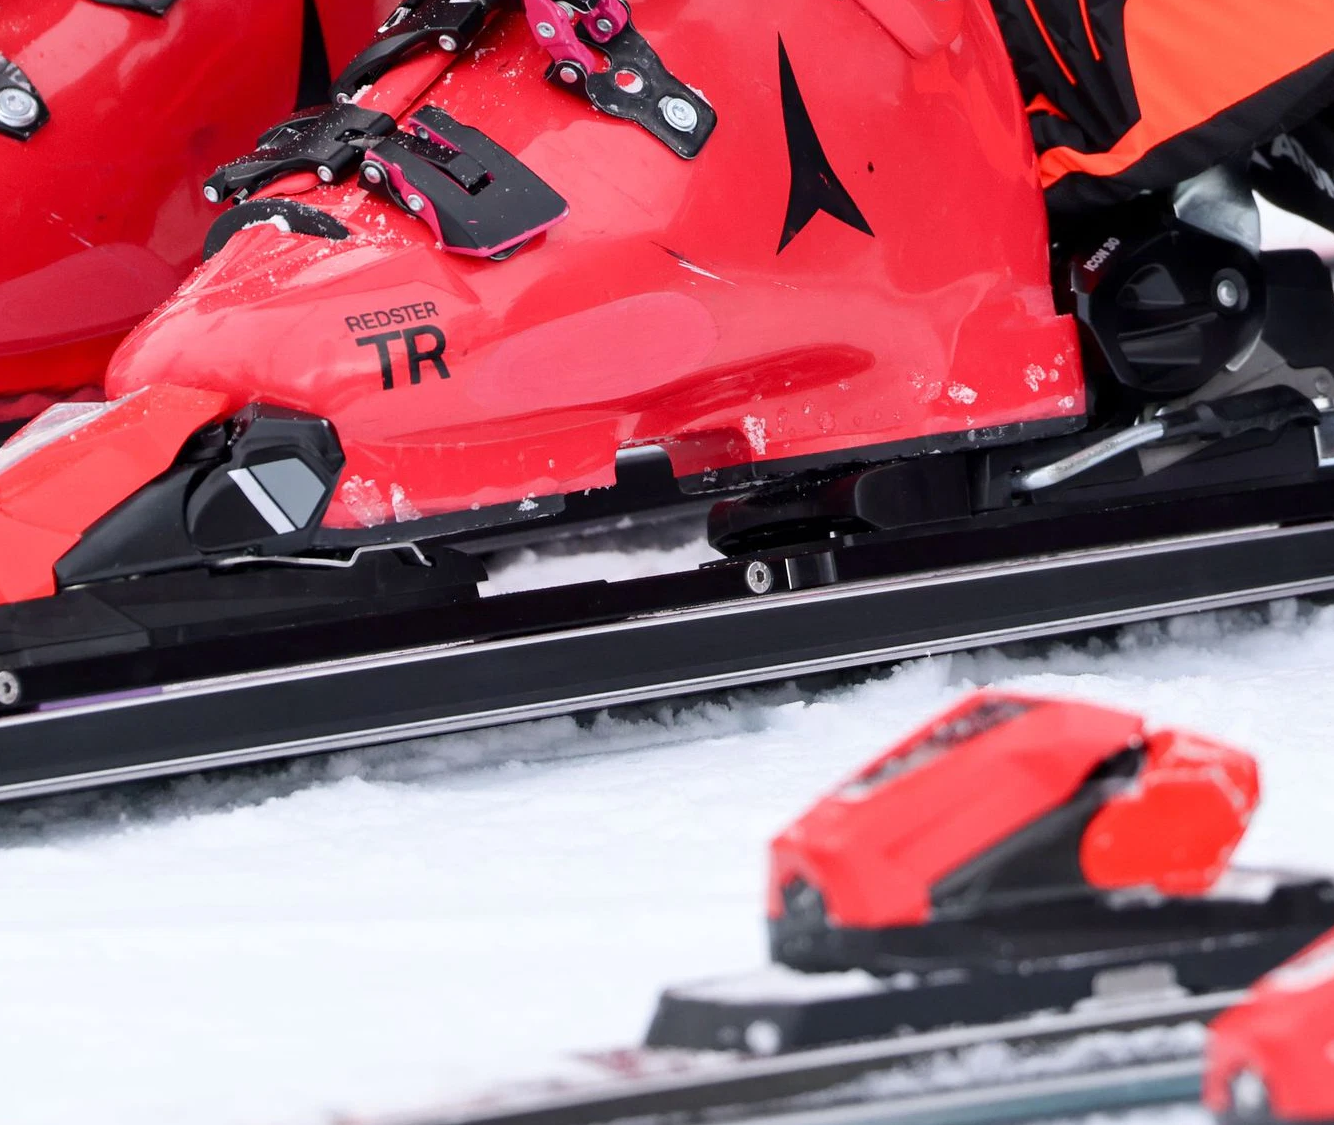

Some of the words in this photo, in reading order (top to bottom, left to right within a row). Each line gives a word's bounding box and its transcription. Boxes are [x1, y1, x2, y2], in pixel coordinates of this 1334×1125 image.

[1083, 248, 1110, 272] ICON
[1102, 237, 1120, 251] 30
[345, 301, 439, 332] REDSTER
[355, 324, 450, 391] TR
